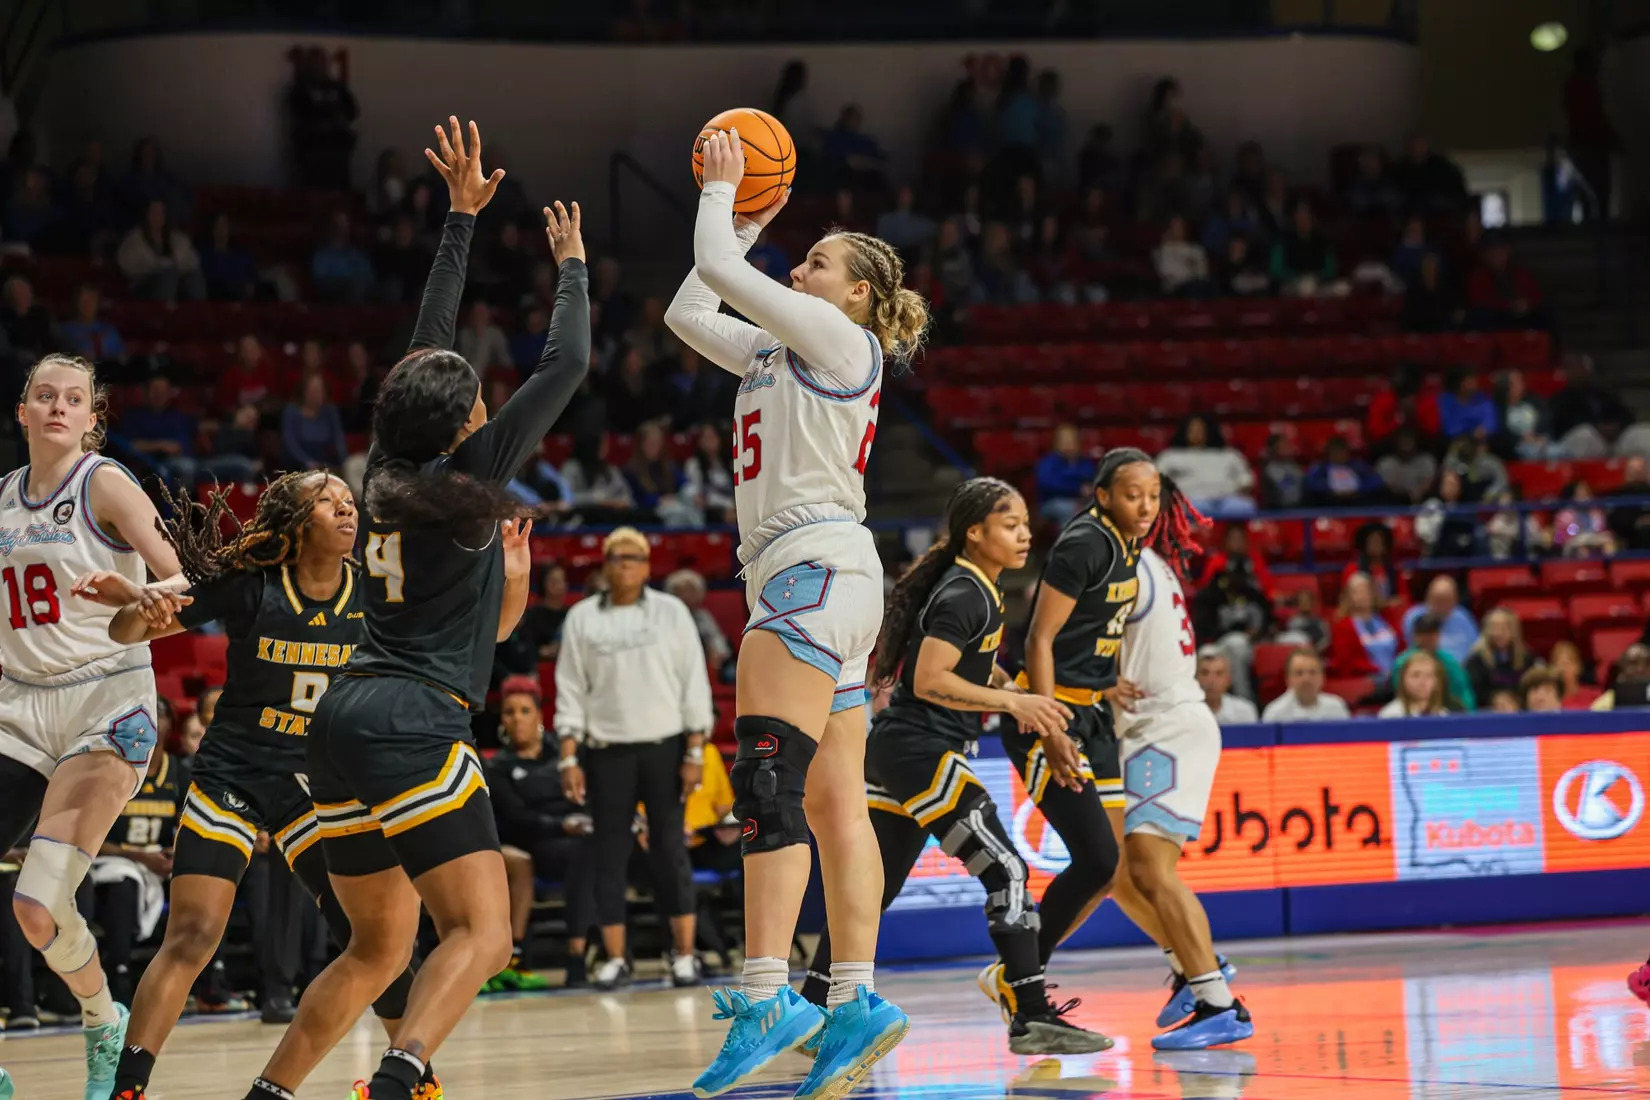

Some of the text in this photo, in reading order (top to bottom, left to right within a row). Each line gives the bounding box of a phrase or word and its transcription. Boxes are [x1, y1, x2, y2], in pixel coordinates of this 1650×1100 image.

[365, 531, 405, 603] 4
[2, 563, 61, 630] 18
[256, 636, 357, 667] KENNESA
[259, 706, 312, 736] STA
[1182, 787, 1382, 856] ubota
[1426, 820, 1536, 850] Kubota
